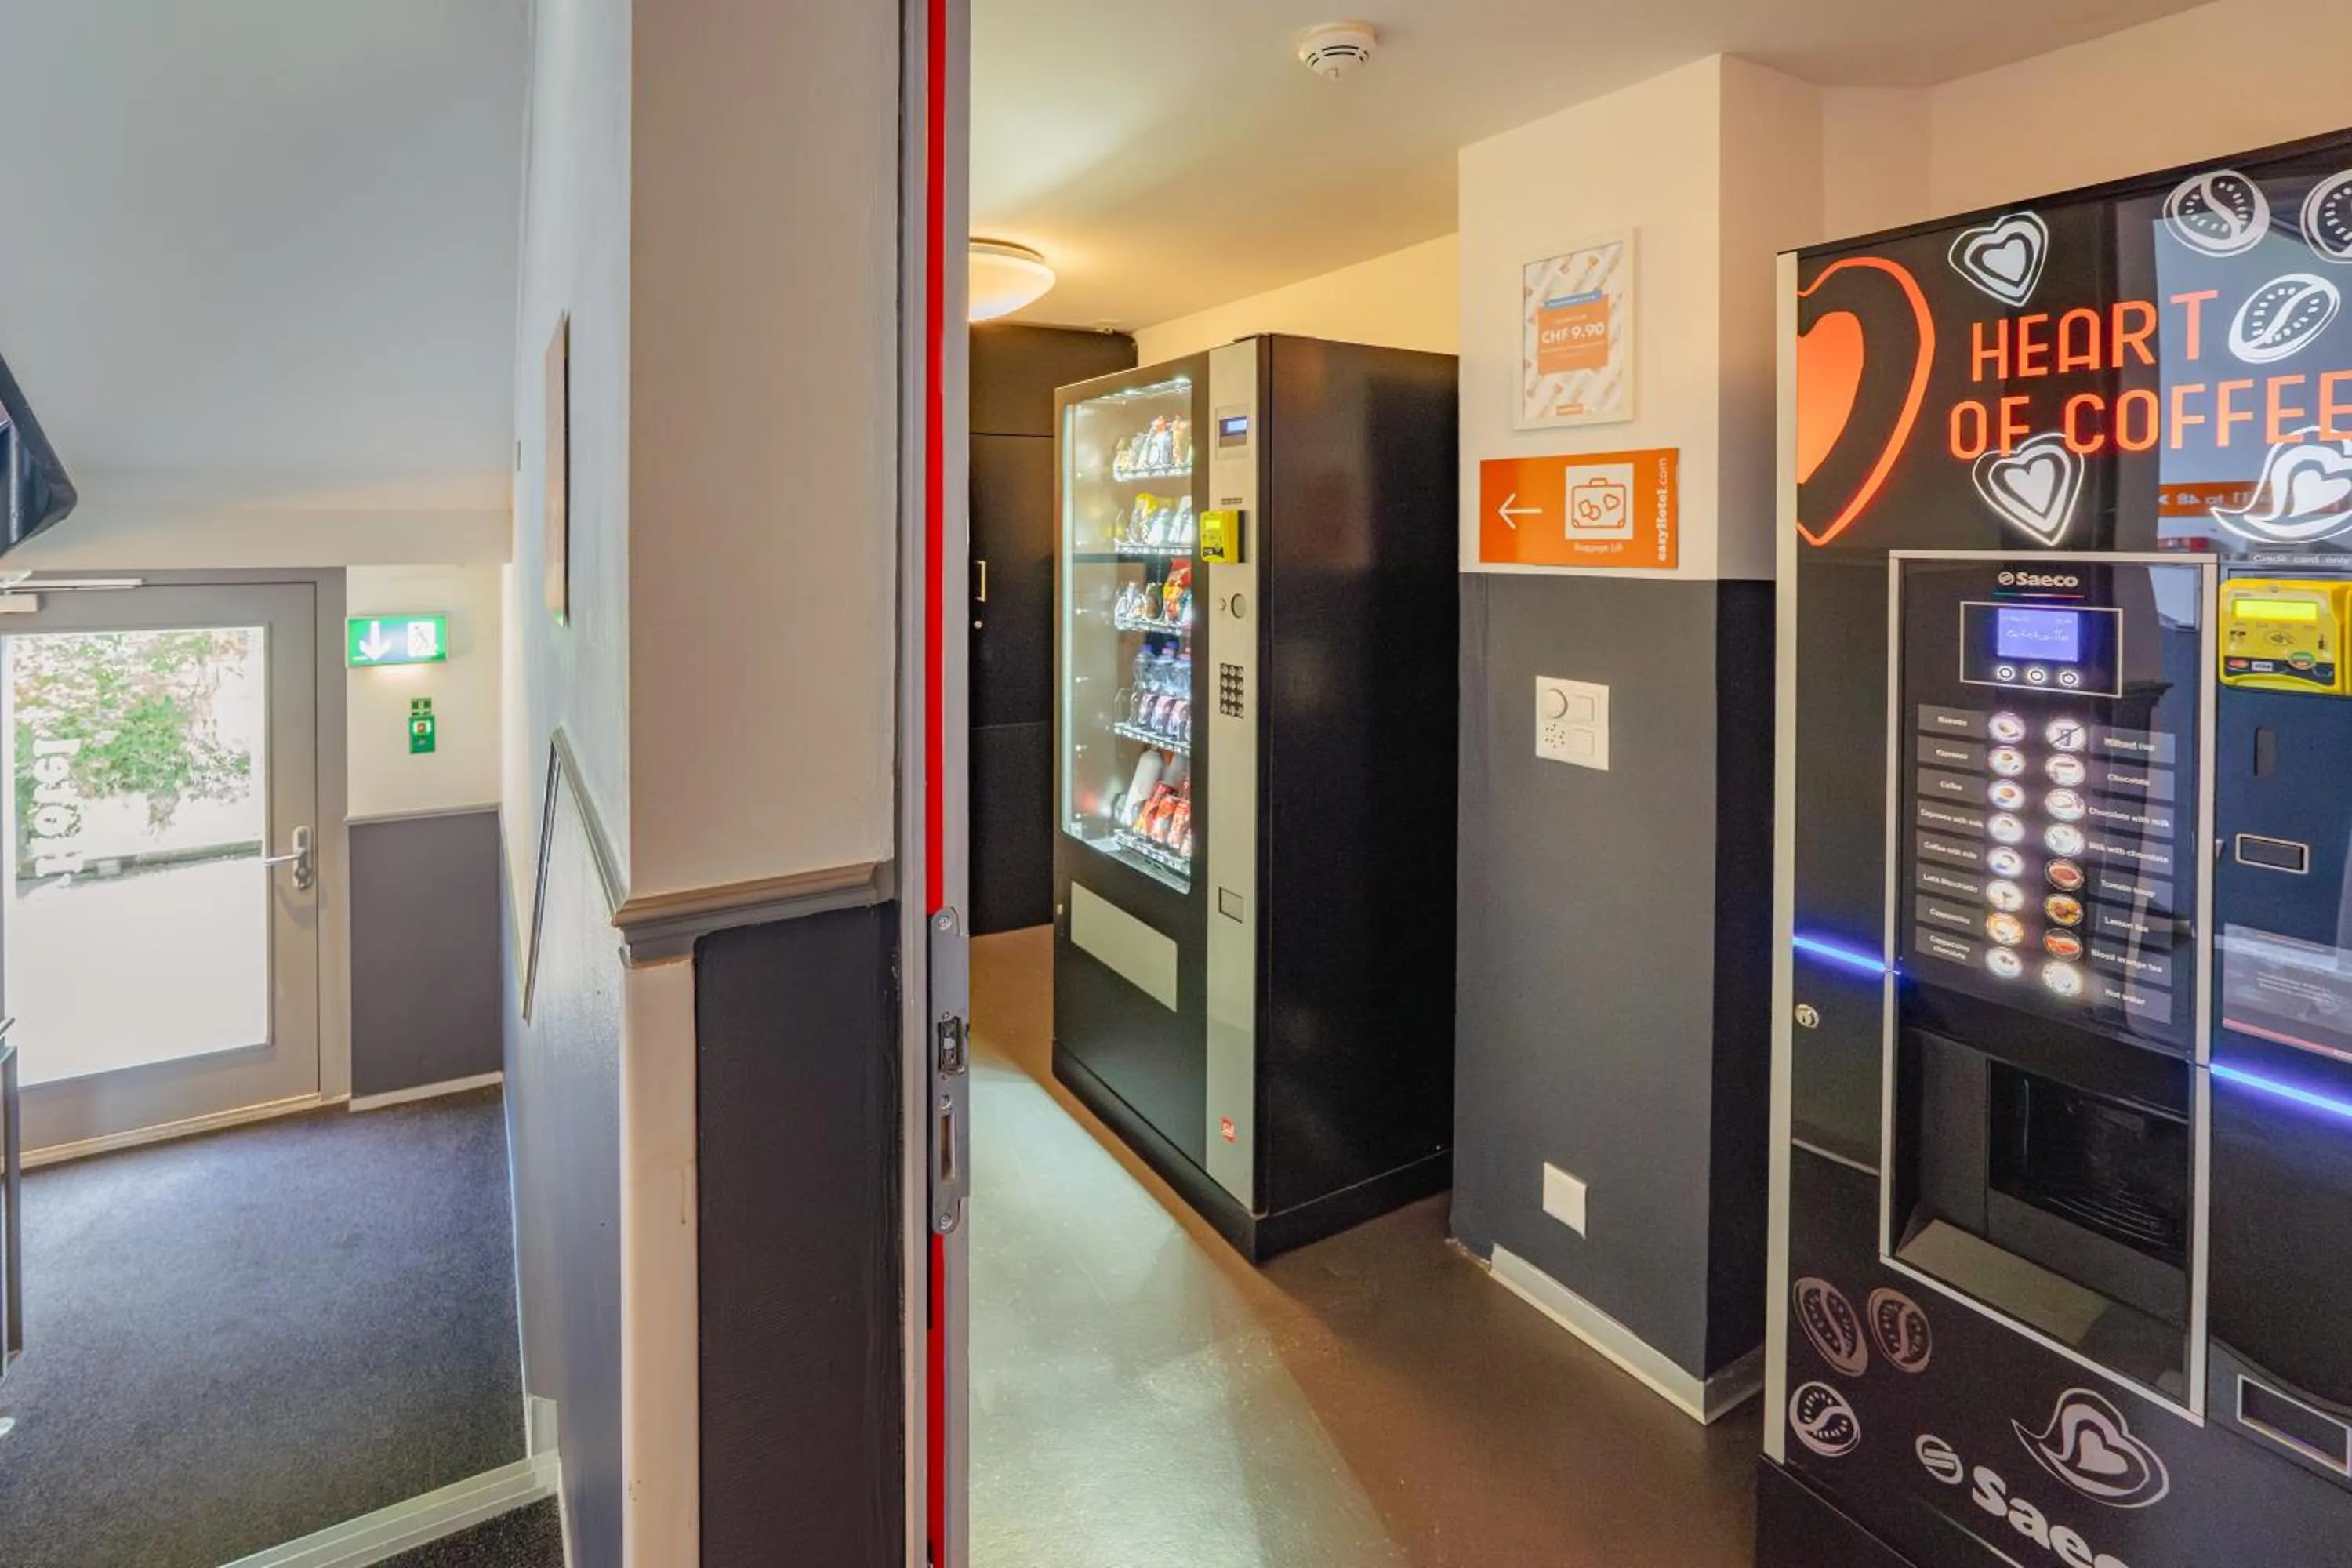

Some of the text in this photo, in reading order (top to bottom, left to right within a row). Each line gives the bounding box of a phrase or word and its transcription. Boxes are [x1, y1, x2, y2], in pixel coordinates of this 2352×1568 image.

[1541, 321, 1605, 344] CHF 9.90
[1971, 289, 2220, 382] HEART
[1950, 368, 2352, 460] OF COFFEE
[2016, 572, 2079, 587] Saeco
